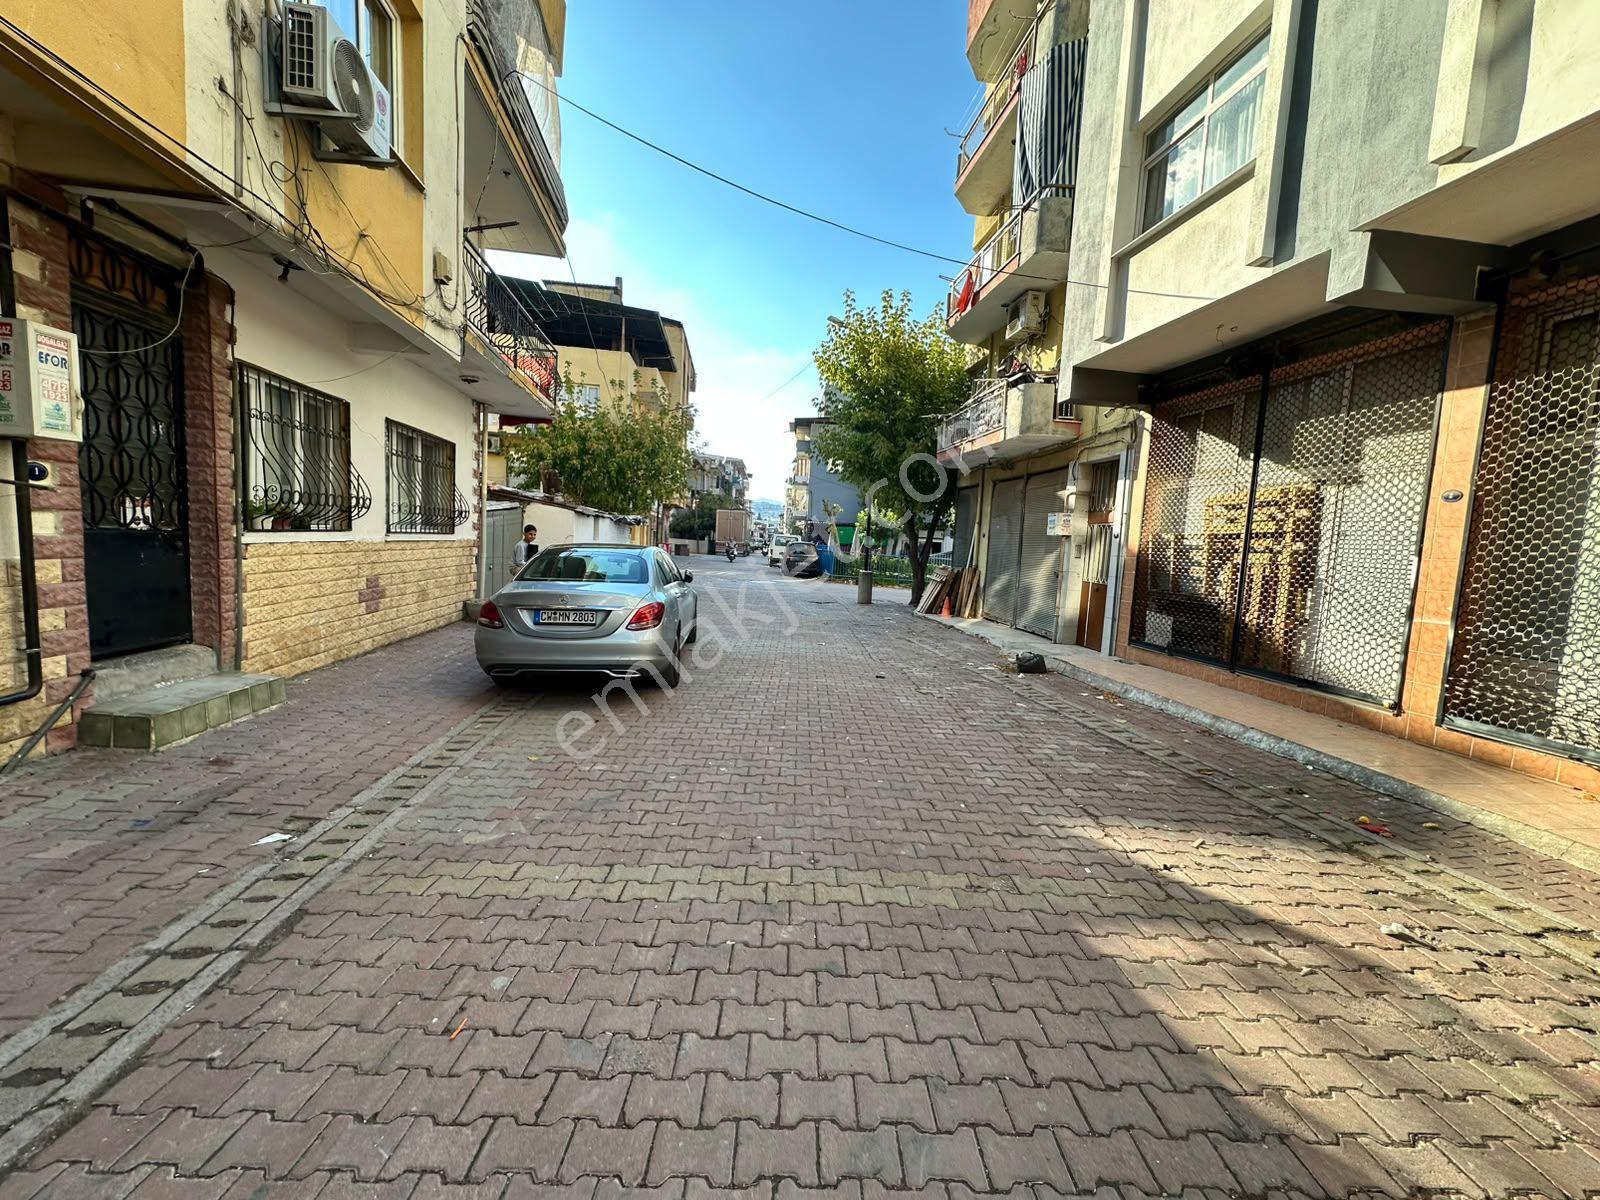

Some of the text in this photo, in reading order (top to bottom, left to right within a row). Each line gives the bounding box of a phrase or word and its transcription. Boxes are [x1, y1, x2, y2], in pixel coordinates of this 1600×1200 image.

[376, 113, 386, 133] LG
[39, 351, 68, 370] EFOR
[43, 390, 68, 402] 1923
[34, 467, 39, 475] 1
[572, 612, 595, 622] 2803
